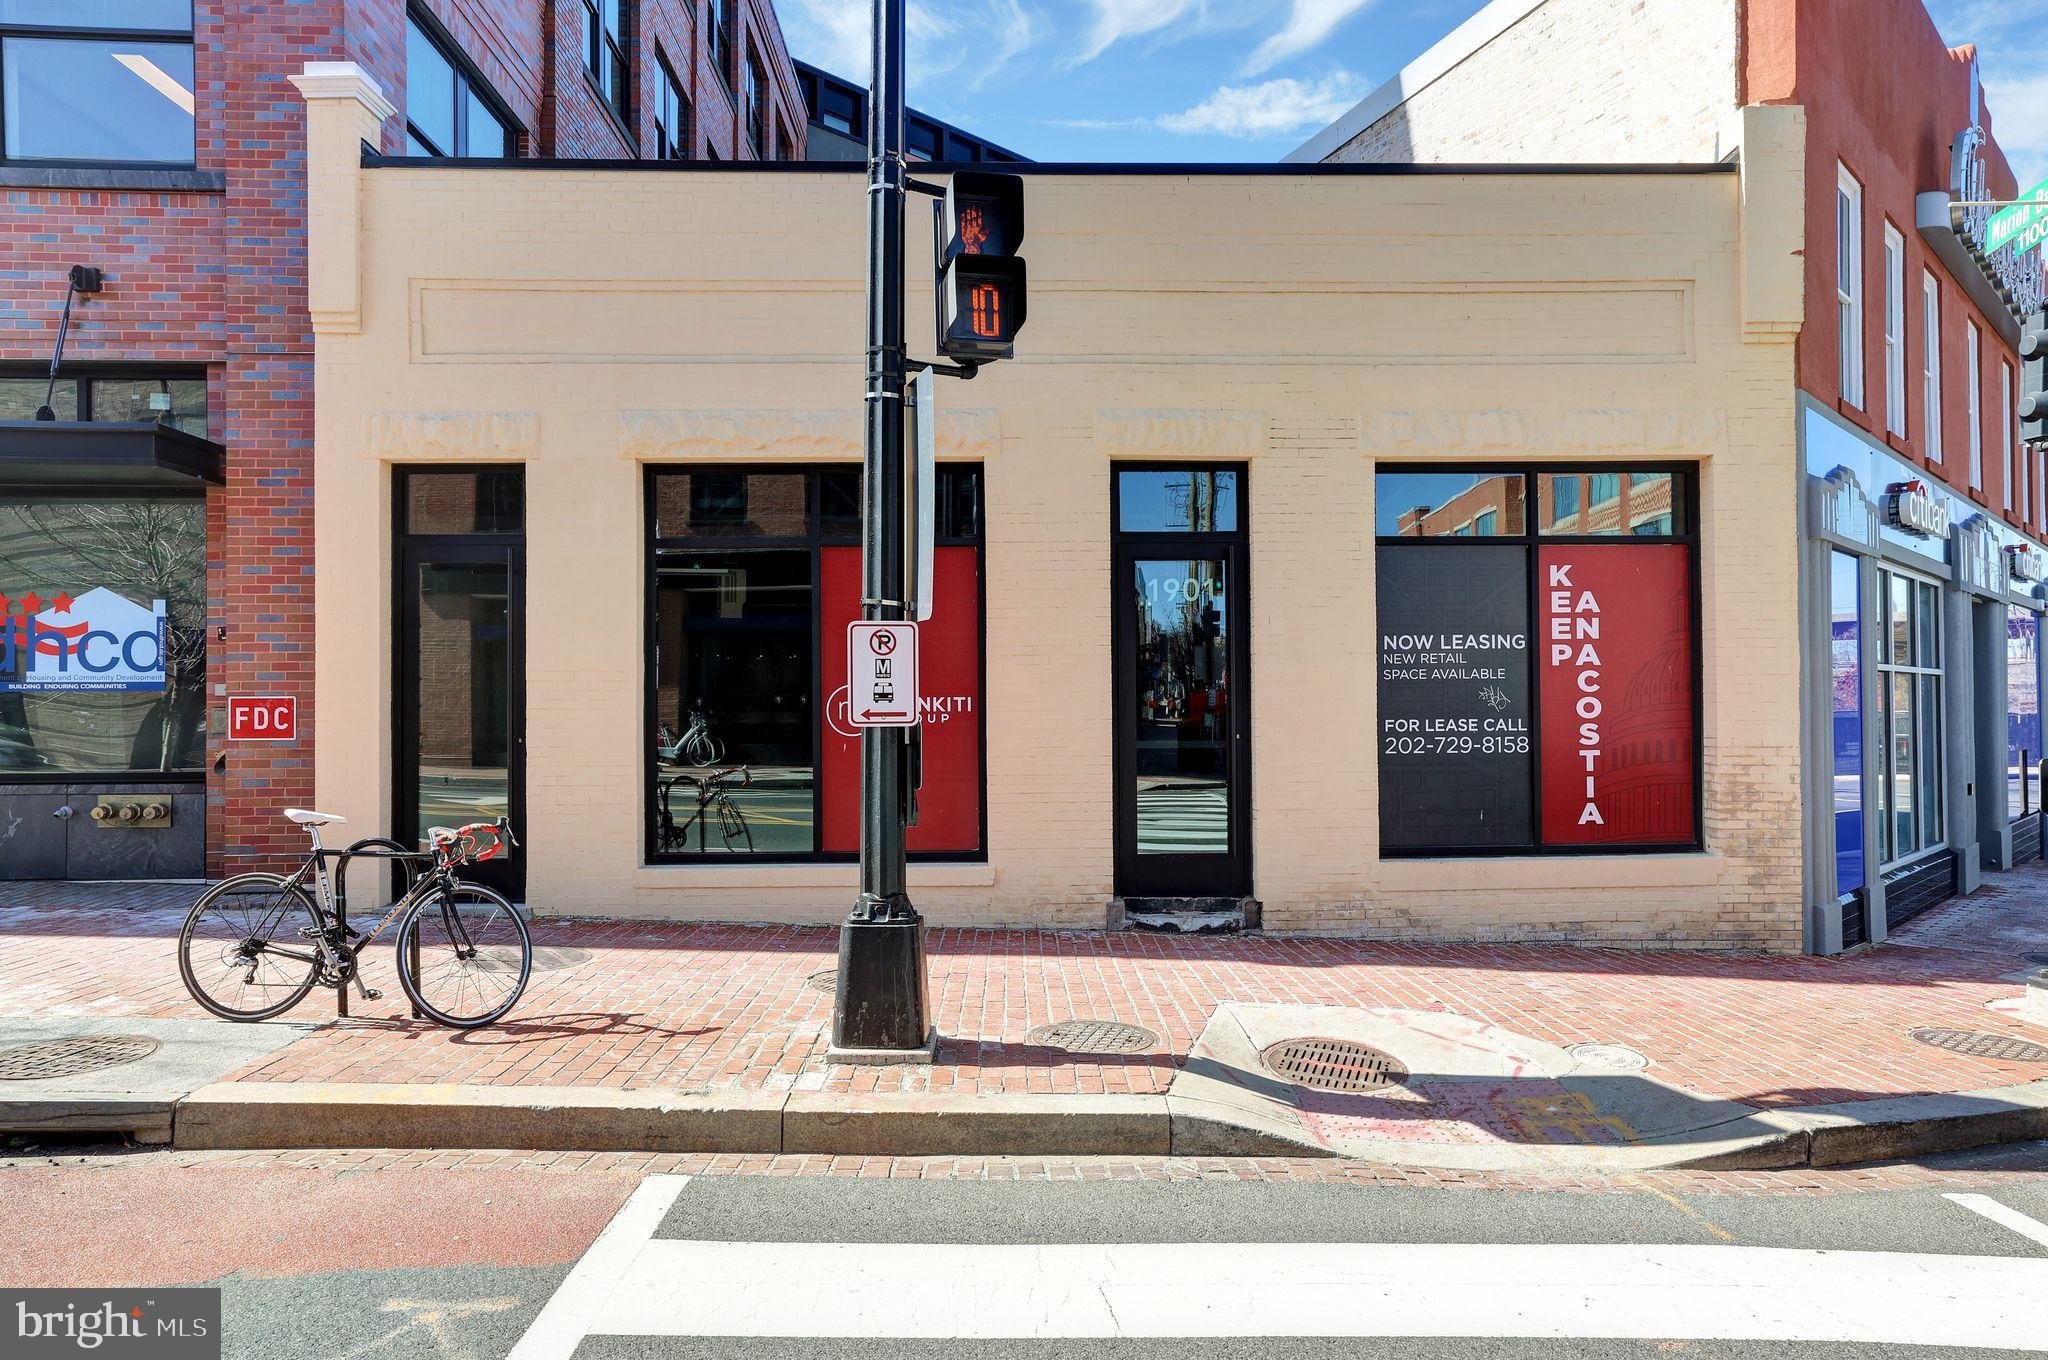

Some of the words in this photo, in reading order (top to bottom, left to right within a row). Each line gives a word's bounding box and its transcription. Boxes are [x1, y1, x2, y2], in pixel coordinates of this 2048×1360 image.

[1991, 203, 2030, 246] Marion
[2018, 216, 2048, 251] 1100
[971, 284, 1000, 336] 10
[1147, 577, 1214, 601] 1901
[1549, 564, 1573, 667] KEEP
[1384, 635, 1434, 650] NOW
[1440, 634, 1526, 649] LEASING
[1383, 653, 1416, 664] NEW
[1420, 653, 1467, 664] RETAIL
[73, 674, 115, 683] Community
[116, 674, 163, 683] Development
[1383, 669, 1427, 680] SPACE
[1431, 668, 1506, 679] AVAILABLE
[919, 696, 972, 712] NKITI
[1575, 590, 1604, 825] ANACOSTIA
[235, 707, 289, 730] FDC
[1385, 719, 1420, 732] FOR
[1425, 719, 1478, 732] LEASE
[1483, 718, 1528, 732] CALL
[1385, 736, 1530, 755] 202-729-8158
